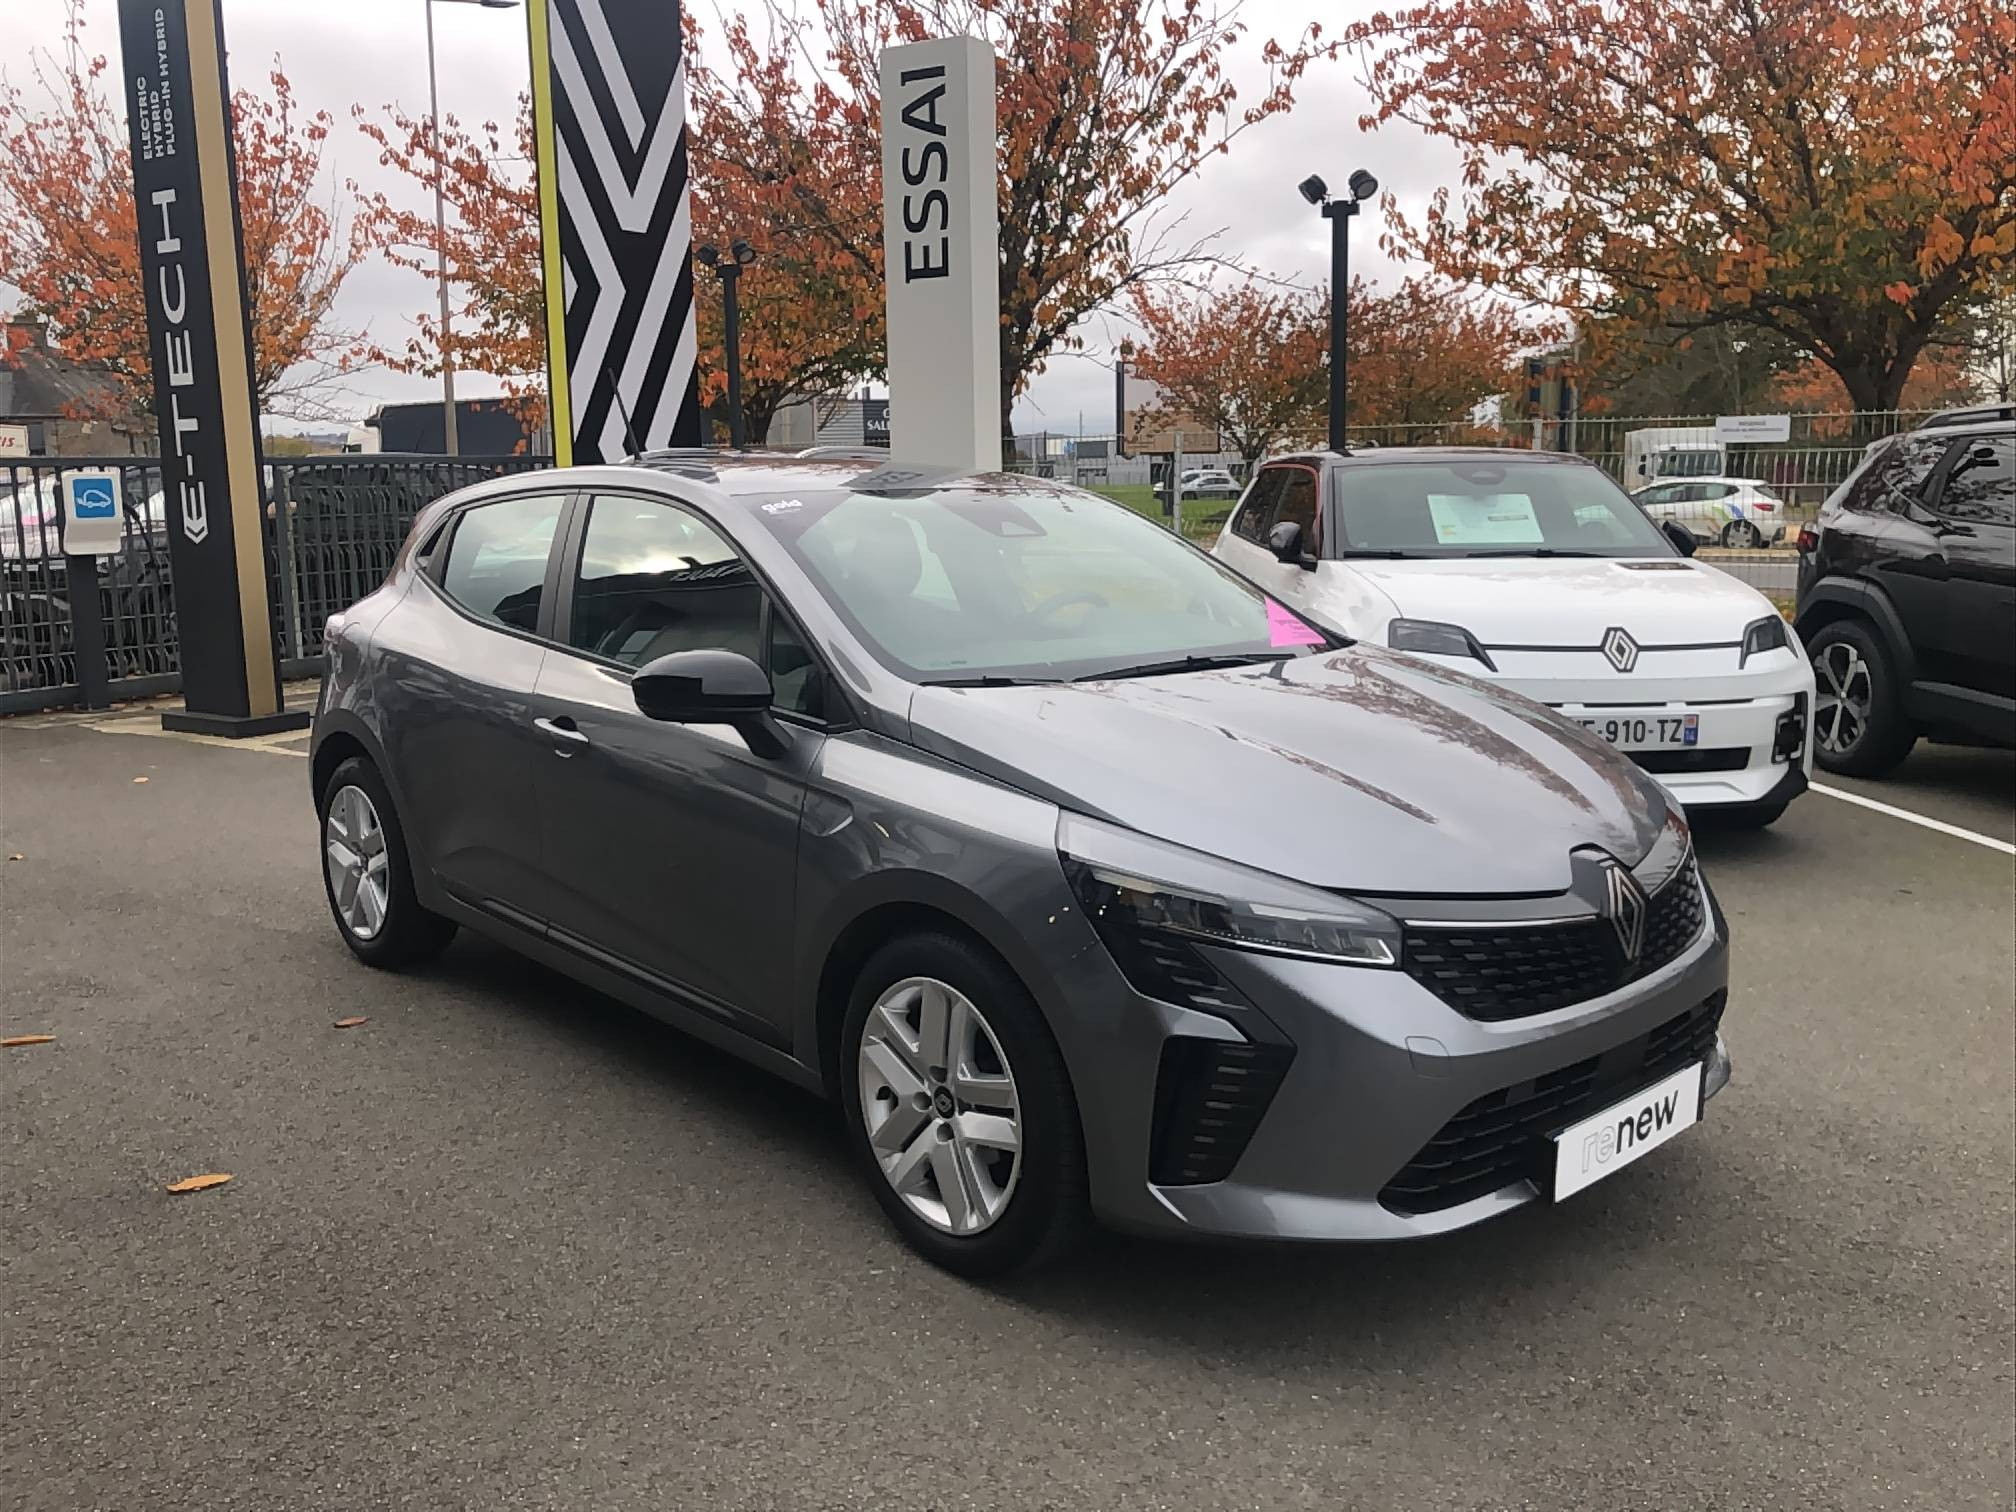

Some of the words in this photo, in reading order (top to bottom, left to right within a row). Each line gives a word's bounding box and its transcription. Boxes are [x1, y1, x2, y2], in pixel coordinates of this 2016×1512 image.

[154, 8, 169, 77] HYBRID
[137, 76, 153, 160] ELECTRIC
[150, 91, 164, 158] HYBRID
[161, 80, 176, 155] PLUG-IN
[901, 65, 949, 284] ESSAI
[151, 188, 208, 544] E-TECH
[1577, 719, 1683, 743] -910-TZ
[1582, 1090, 1679, 1174] renew
